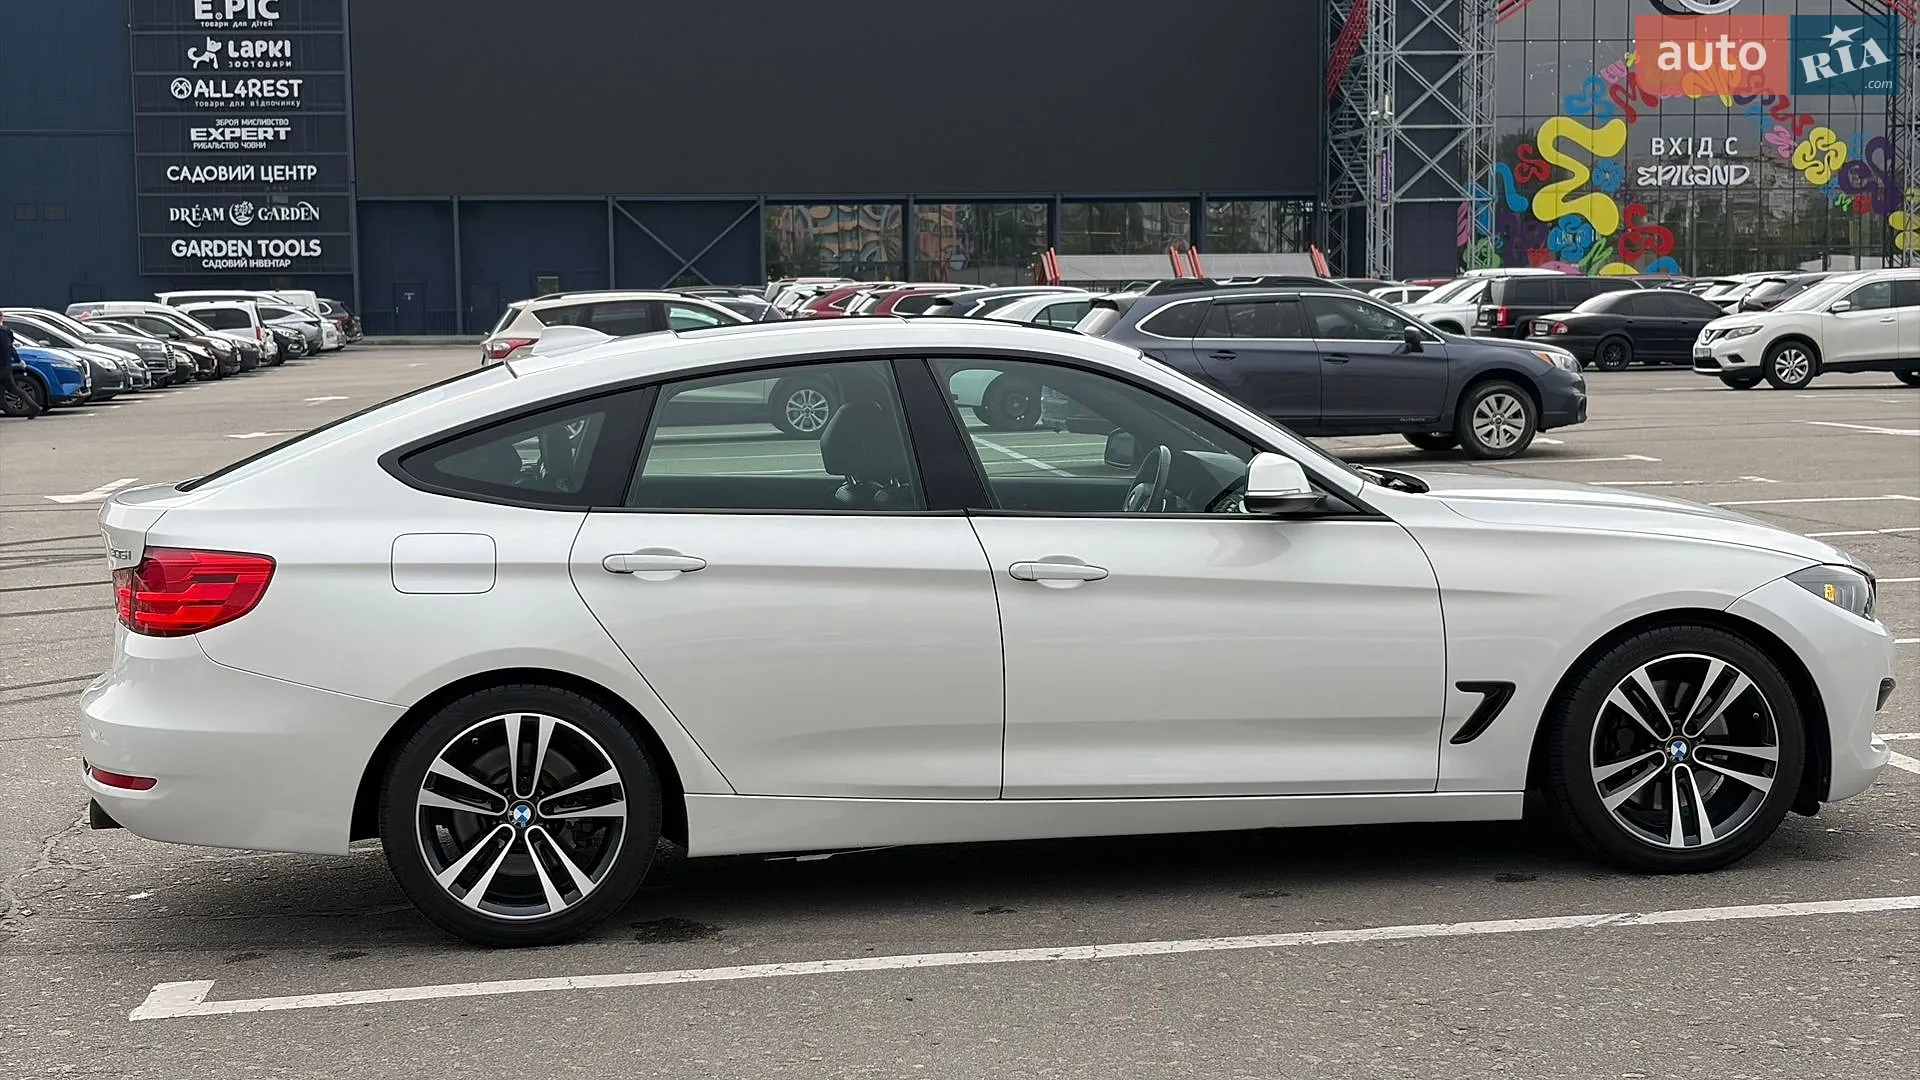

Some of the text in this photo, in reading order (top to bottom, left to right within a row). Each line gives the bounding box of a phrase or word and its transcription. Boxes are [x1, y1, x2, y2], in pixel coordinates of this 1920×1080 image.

[200, 20, 273, 29] товари для дітей
[193, 78, 303, 98] ALL4REST
[250, 100, 301, 108] відпочинку
[215, 118, 289, 126] ЗБРОЯ МИСЛИВСТВО
[190, 127, 291, 141] EXPERT
[241, 141, 267, 149] ЧОВНИ
[1651, 137, 1714, 158] ВХІД
[166, 164, 318, 183] САДОВИЙ ЦЕНТР
[257, 201, 320, 221] GARDEN
[171, 239, 322, 257] GARDEN TOOLS
[202, 258, 291, 269] САДОВИЙ ІНВЕНТАР
